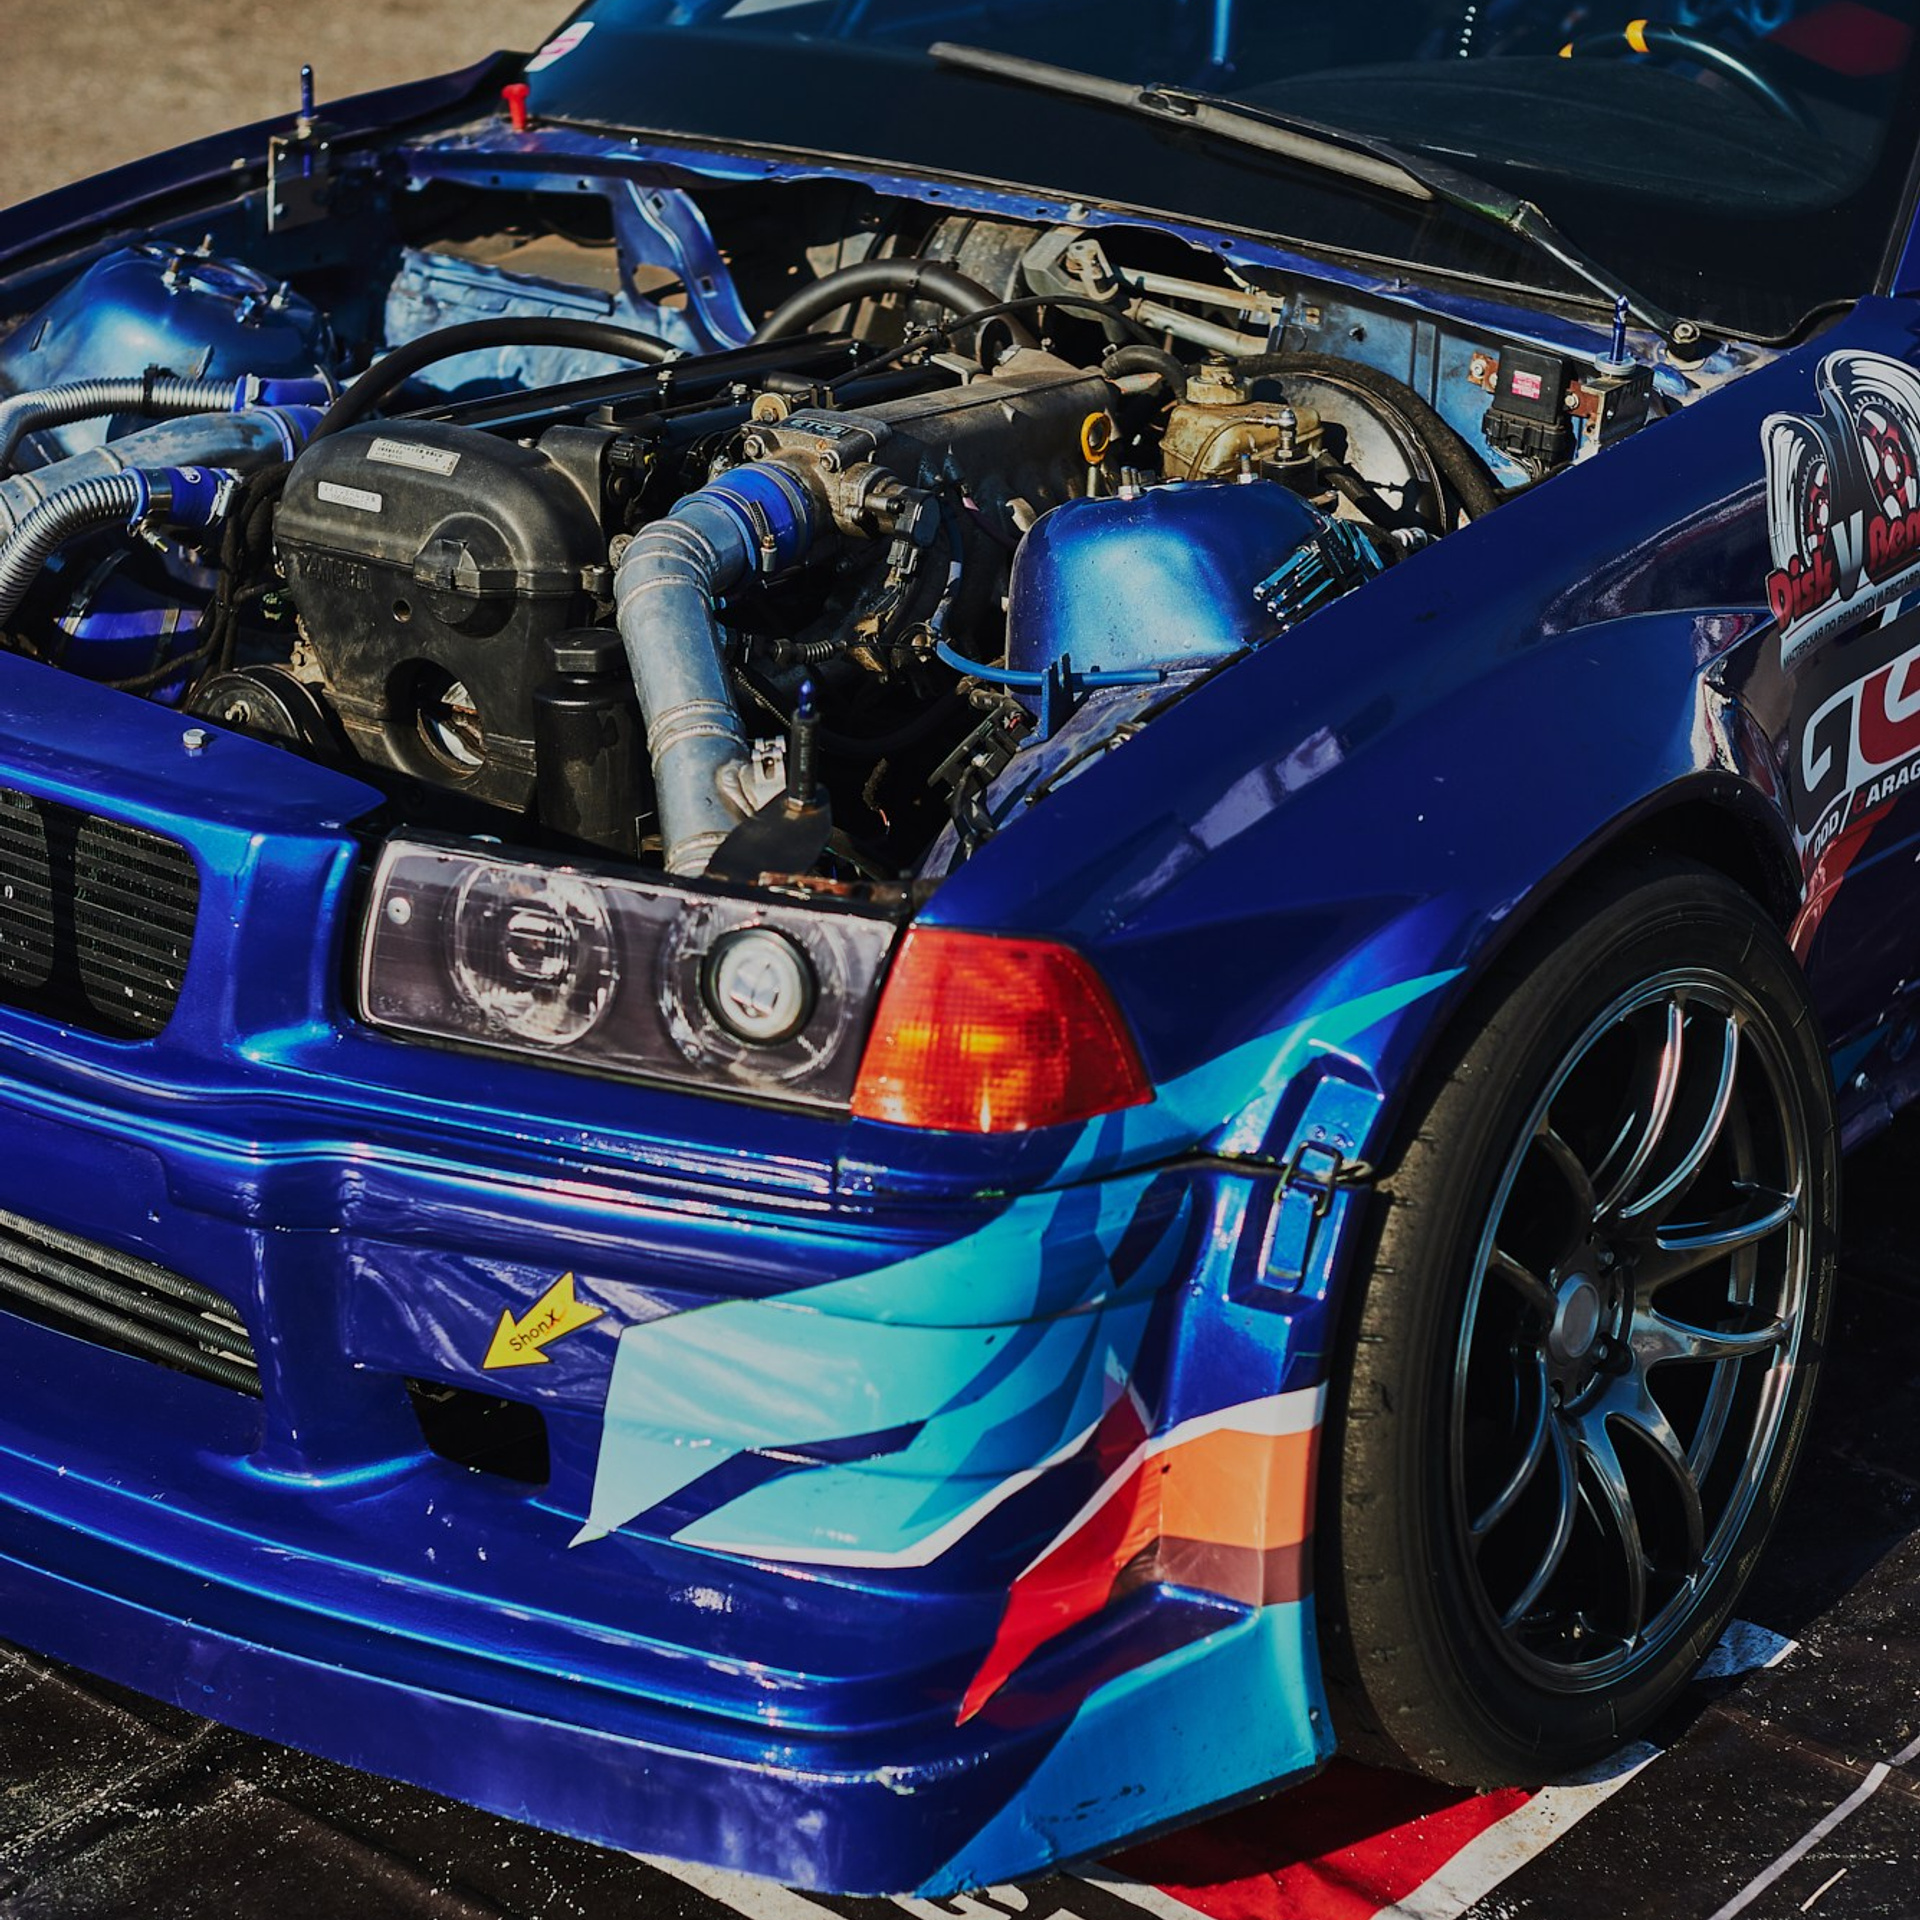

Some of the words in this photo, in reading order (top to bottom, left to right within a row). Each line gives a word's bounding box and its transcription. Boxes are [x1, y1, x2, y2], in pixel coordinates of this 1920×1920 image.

[1768, 549, 1832, 630] Disk
[1831, 509, 1864, 594] V
[1783, 627, 1823, 666] МАСТЕРСКАЯ
[1824, 618, 1836, 635] ПО
